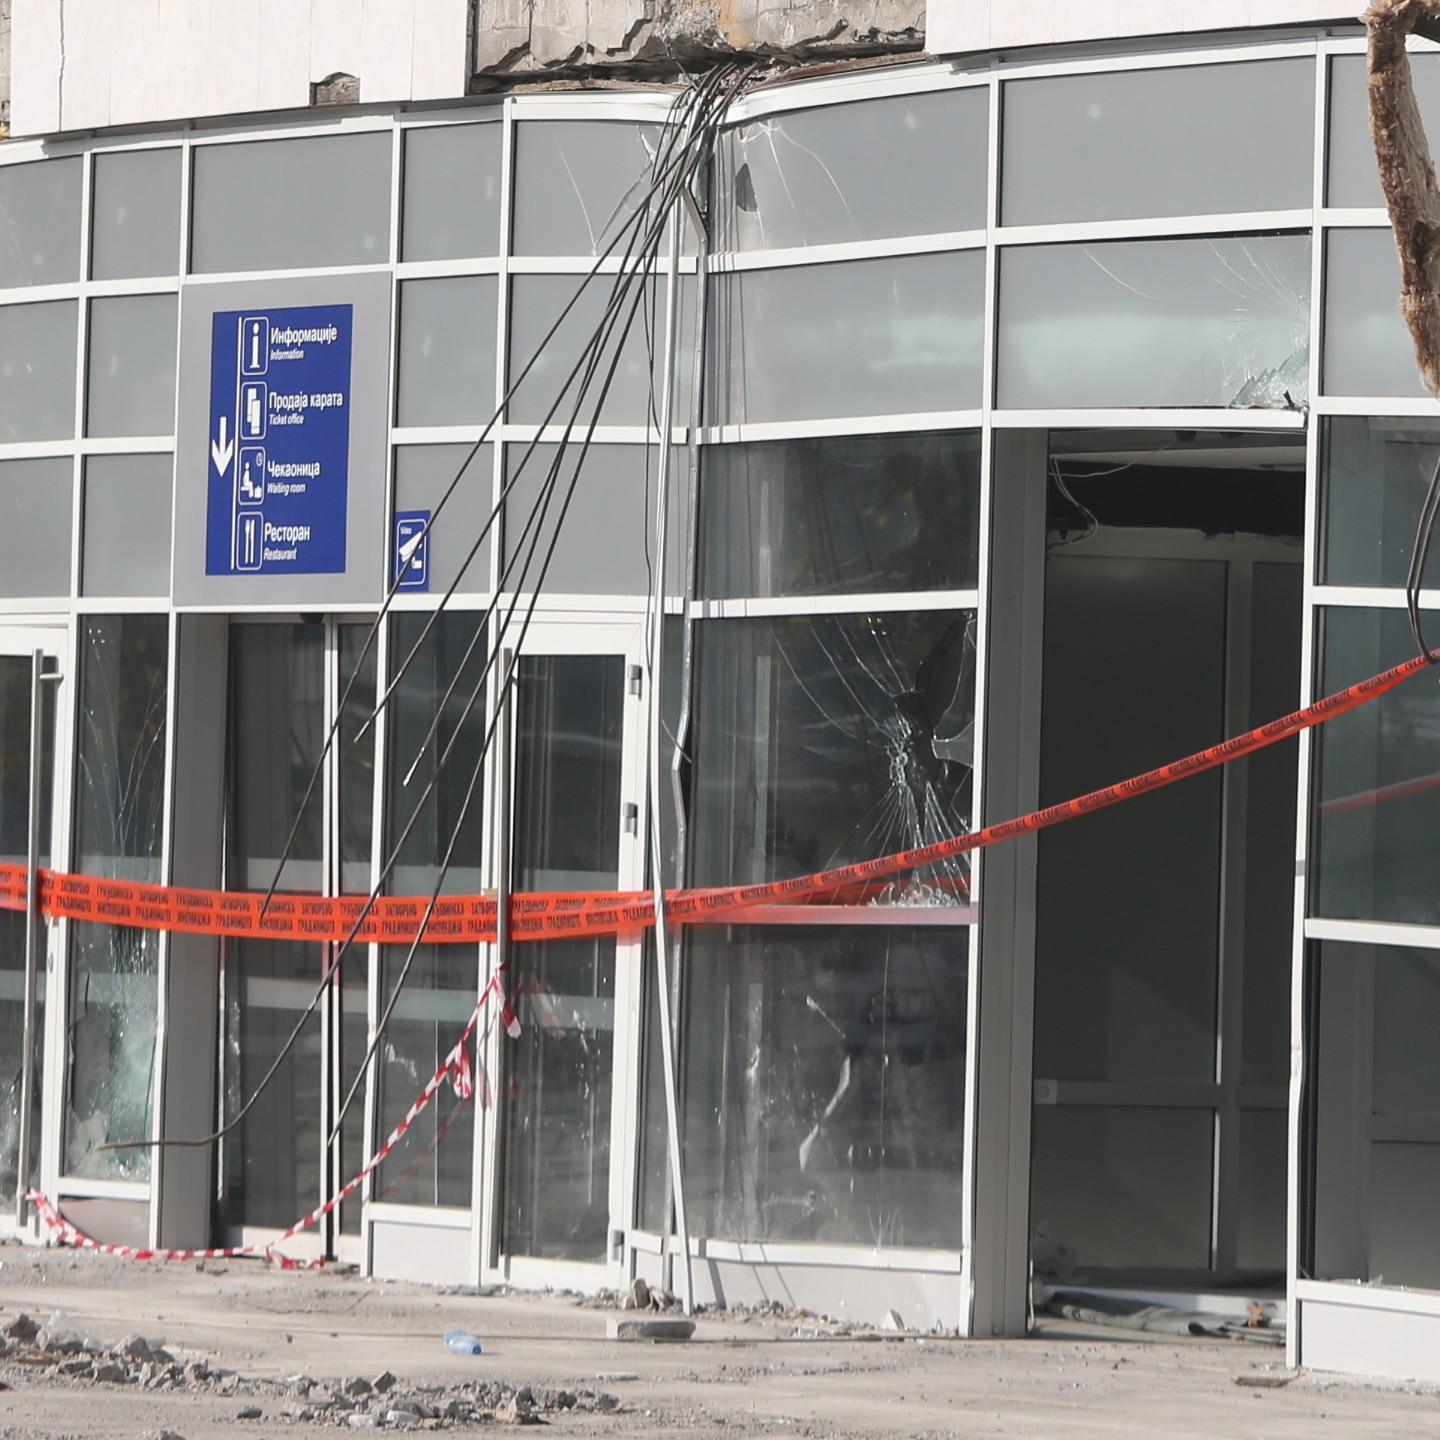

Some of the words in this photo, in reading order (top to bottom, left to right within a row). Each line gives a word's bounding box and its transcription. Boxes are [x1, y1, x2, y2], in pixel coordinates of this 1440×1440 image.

[270, 323, 338, 347] Информације
[269, 347, 304, 360] Information
[268, 390, 308, 412] Продаја
[310, 392, 343, 411] карата
[269, 414, 287, 426] Ticket
[287, 413, 304, 425] office
[267, 460, 320, 479] Чекаоница
[266, 482, 290, 497] Waiting
[290, 483, 306, 495] room
[264, 522, 311, 546] Ресторан
[263, 547, 297, 561] Restaurant
